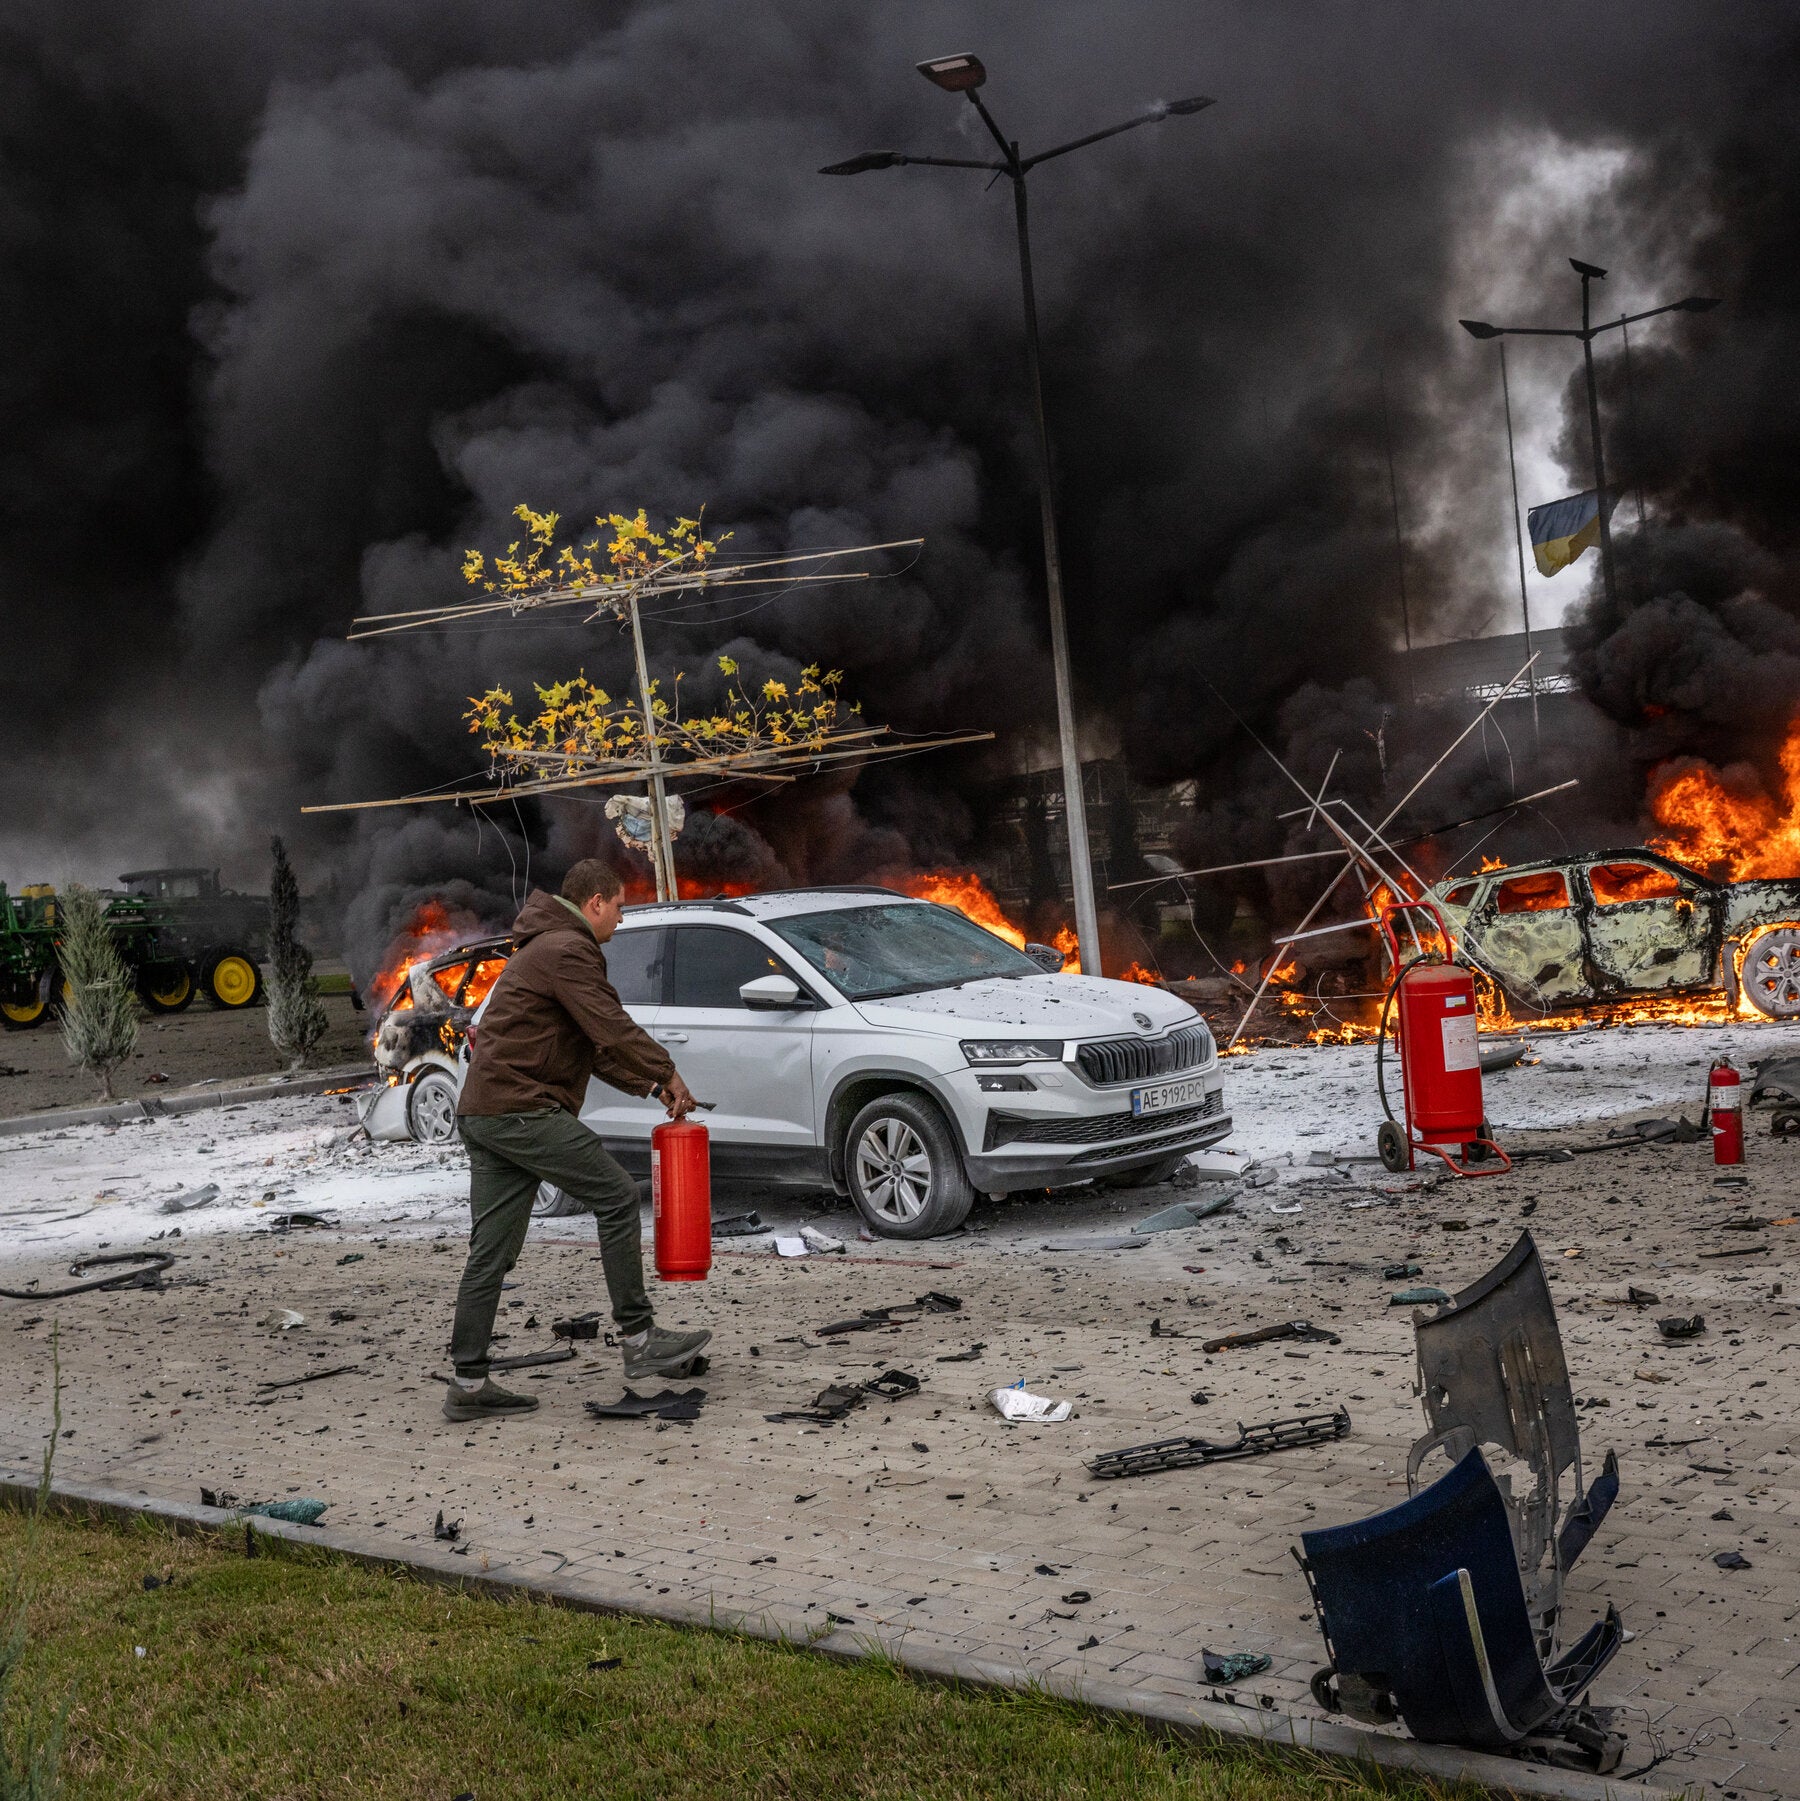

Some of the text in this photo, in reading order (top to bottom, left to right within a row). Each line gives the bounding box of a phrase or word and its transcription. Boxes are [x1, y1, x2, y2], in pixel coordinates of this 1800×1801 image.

[1143, 1090, 1159, 1109] AE
[1161, 1085, 1186, 1105] 9192
[1187, 1082, 1202, 1100] PC
